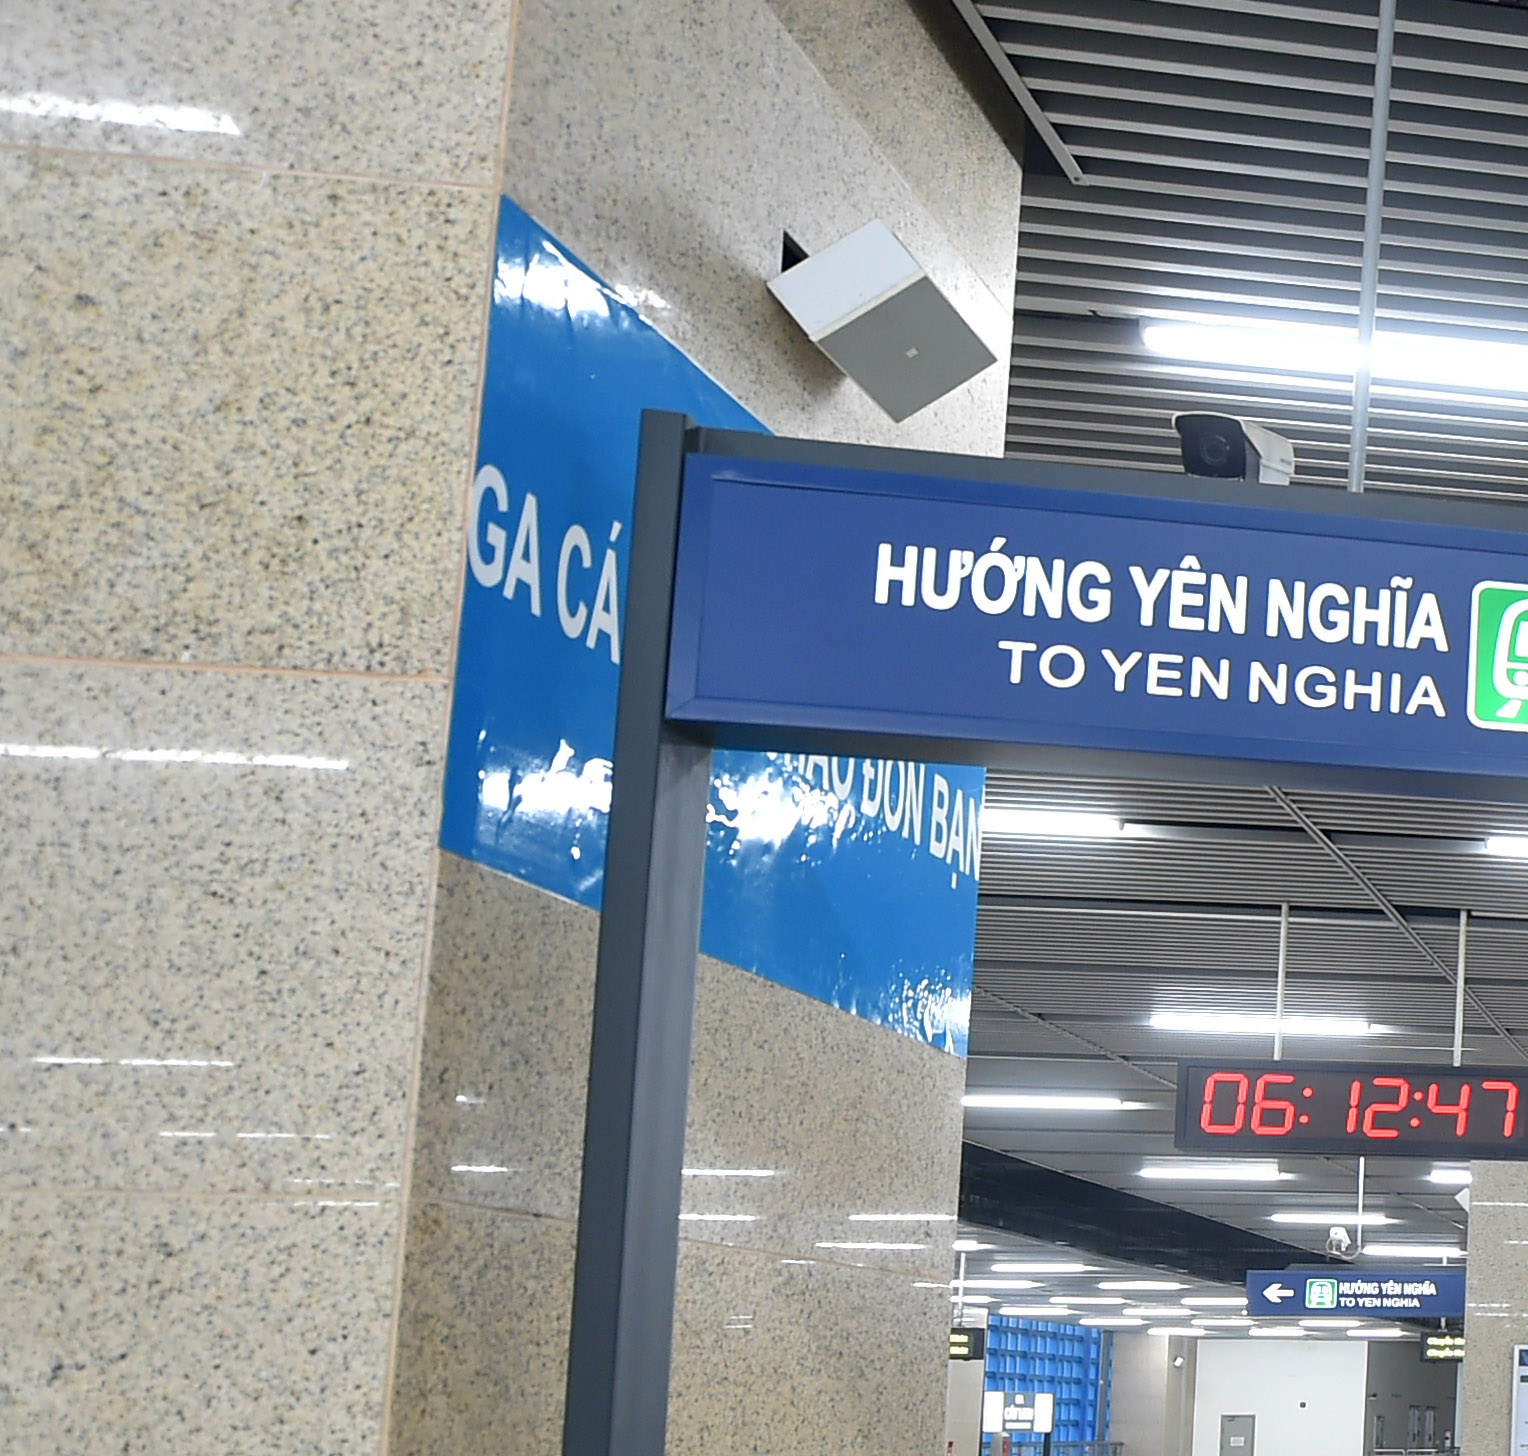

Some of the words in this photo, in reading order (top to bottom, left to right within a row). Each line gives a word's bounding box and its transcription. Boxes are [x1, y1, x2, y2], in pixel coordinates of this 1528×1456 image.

[467, 464, 541, 617] GA
[874, 537, 1112, 624] HƯỚNG
[1129, 554, 1248, 635] YÊN
[1265, 576, 1450, 652] NGHĨA
[998, 640, 1087, 689] TO
[1101, 648, 1230, 700] YEN
[1248, 661, 1446, 718] NGHIA
[1339, 1297, 1355, 1307] TO
[1357, 1297, 1380, 1307] YEN
[1382, 1297, 1420, 1307] NGHIA
